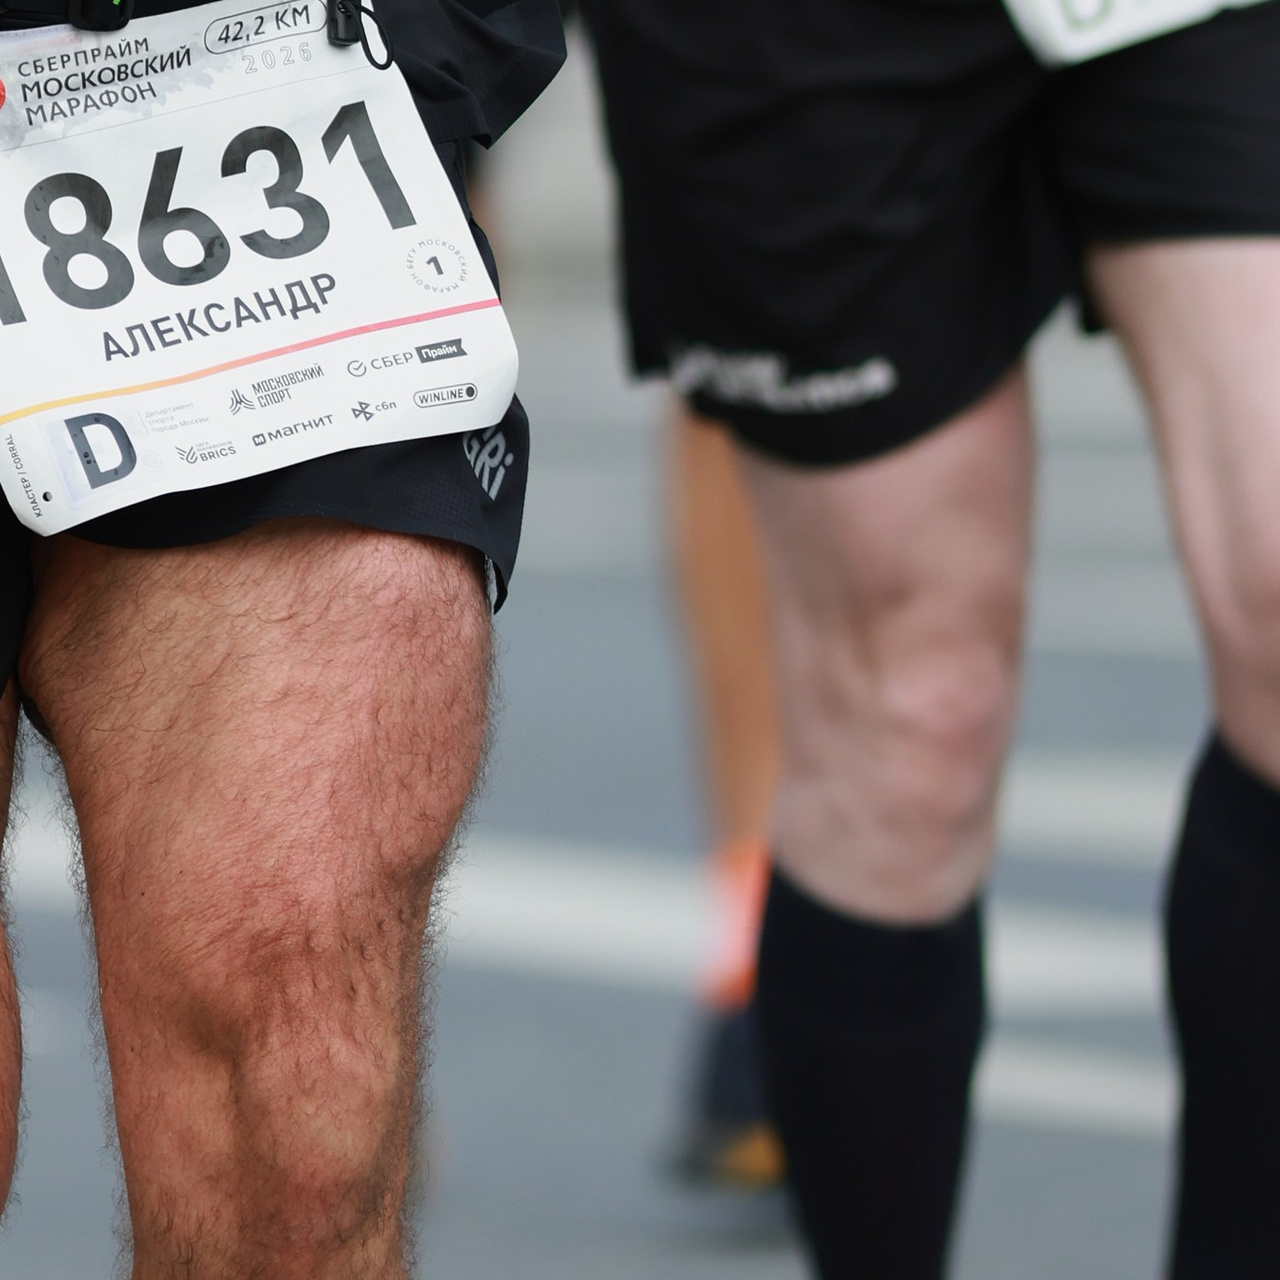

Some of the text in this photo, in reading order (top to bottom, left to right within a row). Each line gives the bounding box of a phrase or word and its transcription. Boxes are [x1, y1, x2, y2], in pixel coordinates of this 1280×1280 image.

[218, 5, 310, 44] 42,2 КМ
[18, 38, 149, 77] СБЕРПРАЙМ
[21, 45, 191, 102] МОСКОВСКИЙ
[242, 42, 312, 74] 2026
[25, 81, 157, 126] МАРАФОН
[418, 239, 468, 282] МОСКОВСКИЙ
[426, 256, 444, 275] 1
[411, 273, 460, 293] МАРАФОН
[102, 273, 337, 361] АЛЕКСАНДР
[370, 344, 457, 370] СБЕР Прайм
[251, 363, 324, 395] МОСКОВСКИЙ
[145, 402, 194, 418] Департамент
[258, 388, 292, 408] СПОРТ
[419, 388, 463, 404] WINLINE
[179, 416, 209, 427] Москвы
[4, 434, 23, 470] CORRAL
[64, 412, 137, 490] D
[199, 446, 236, 461] BRICS
[21, 478, 42, 517] КЛАСТЕР
